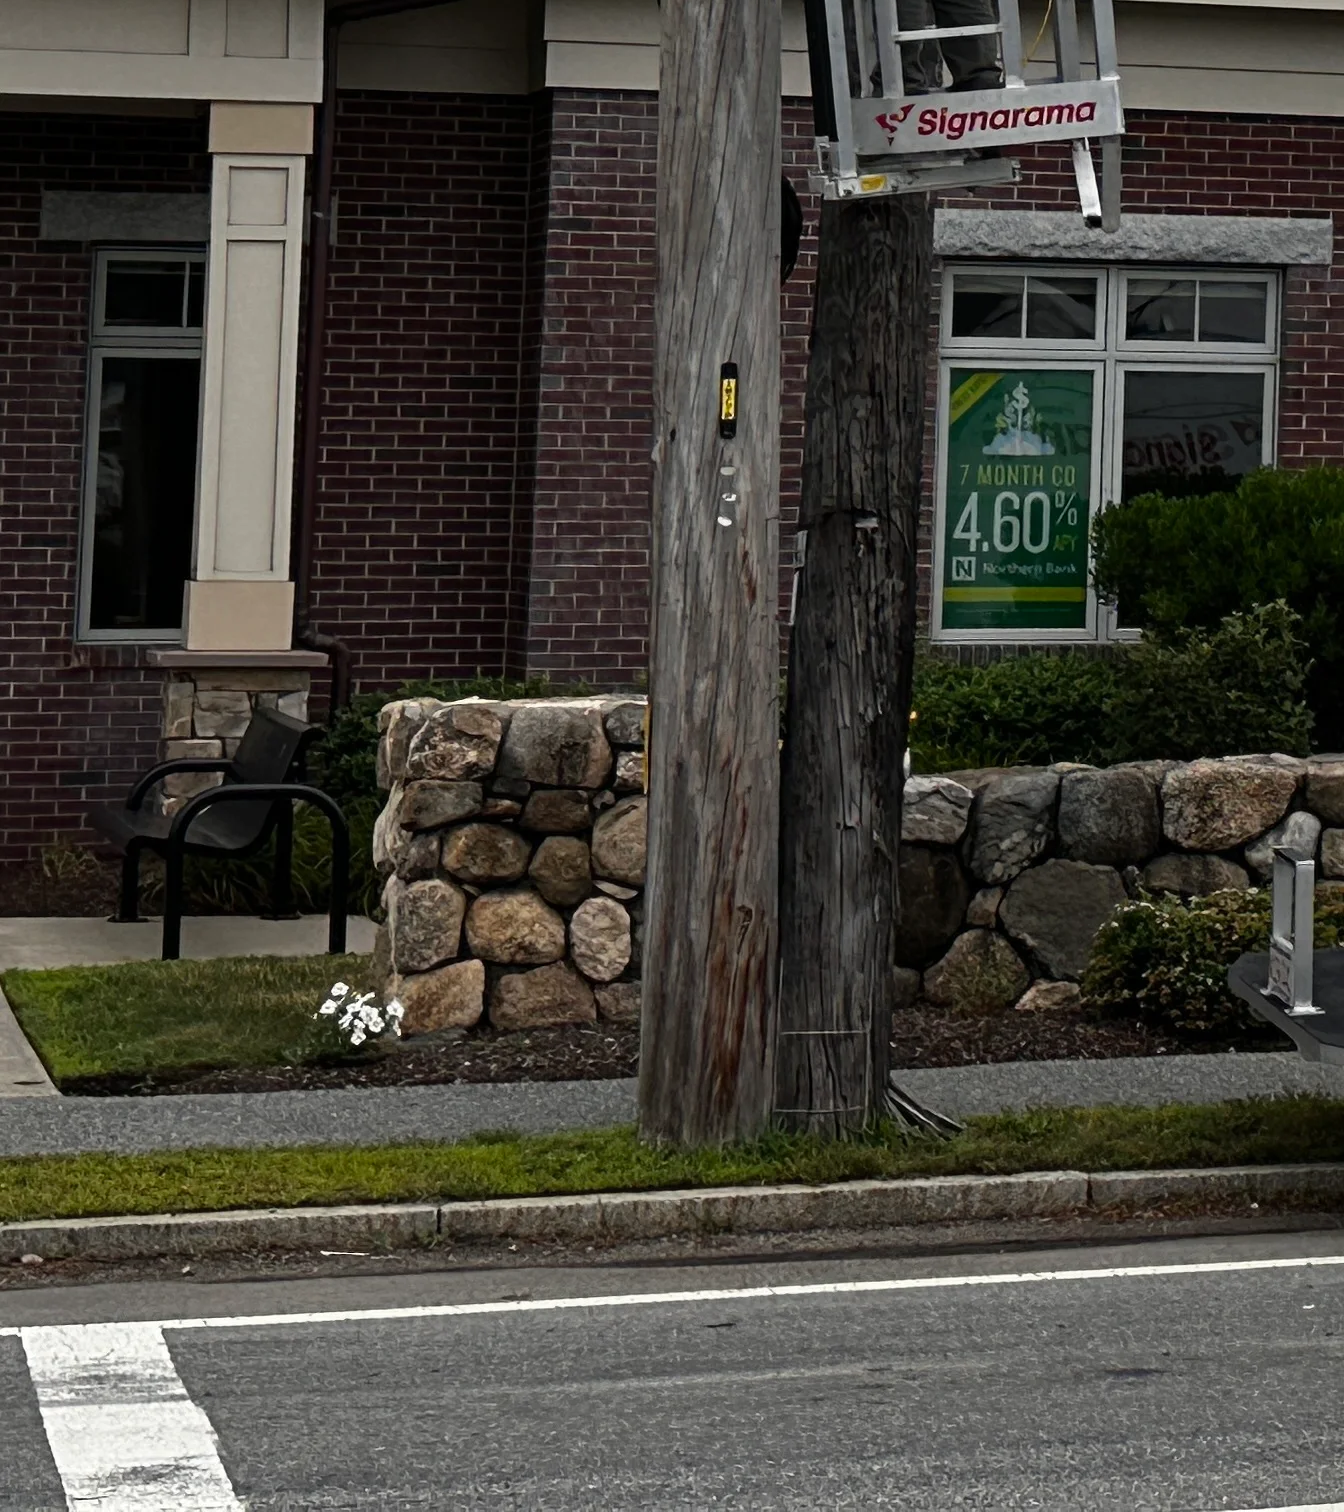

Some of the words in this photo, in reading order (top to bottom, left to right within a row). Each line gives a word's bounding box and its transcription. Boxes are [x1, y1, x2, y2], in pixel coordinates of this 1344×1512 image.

[917, 101, 1097, 141] Signarama
[959, 464, 970, 486] 7
[977, 464, 1044, 487] MONTH
